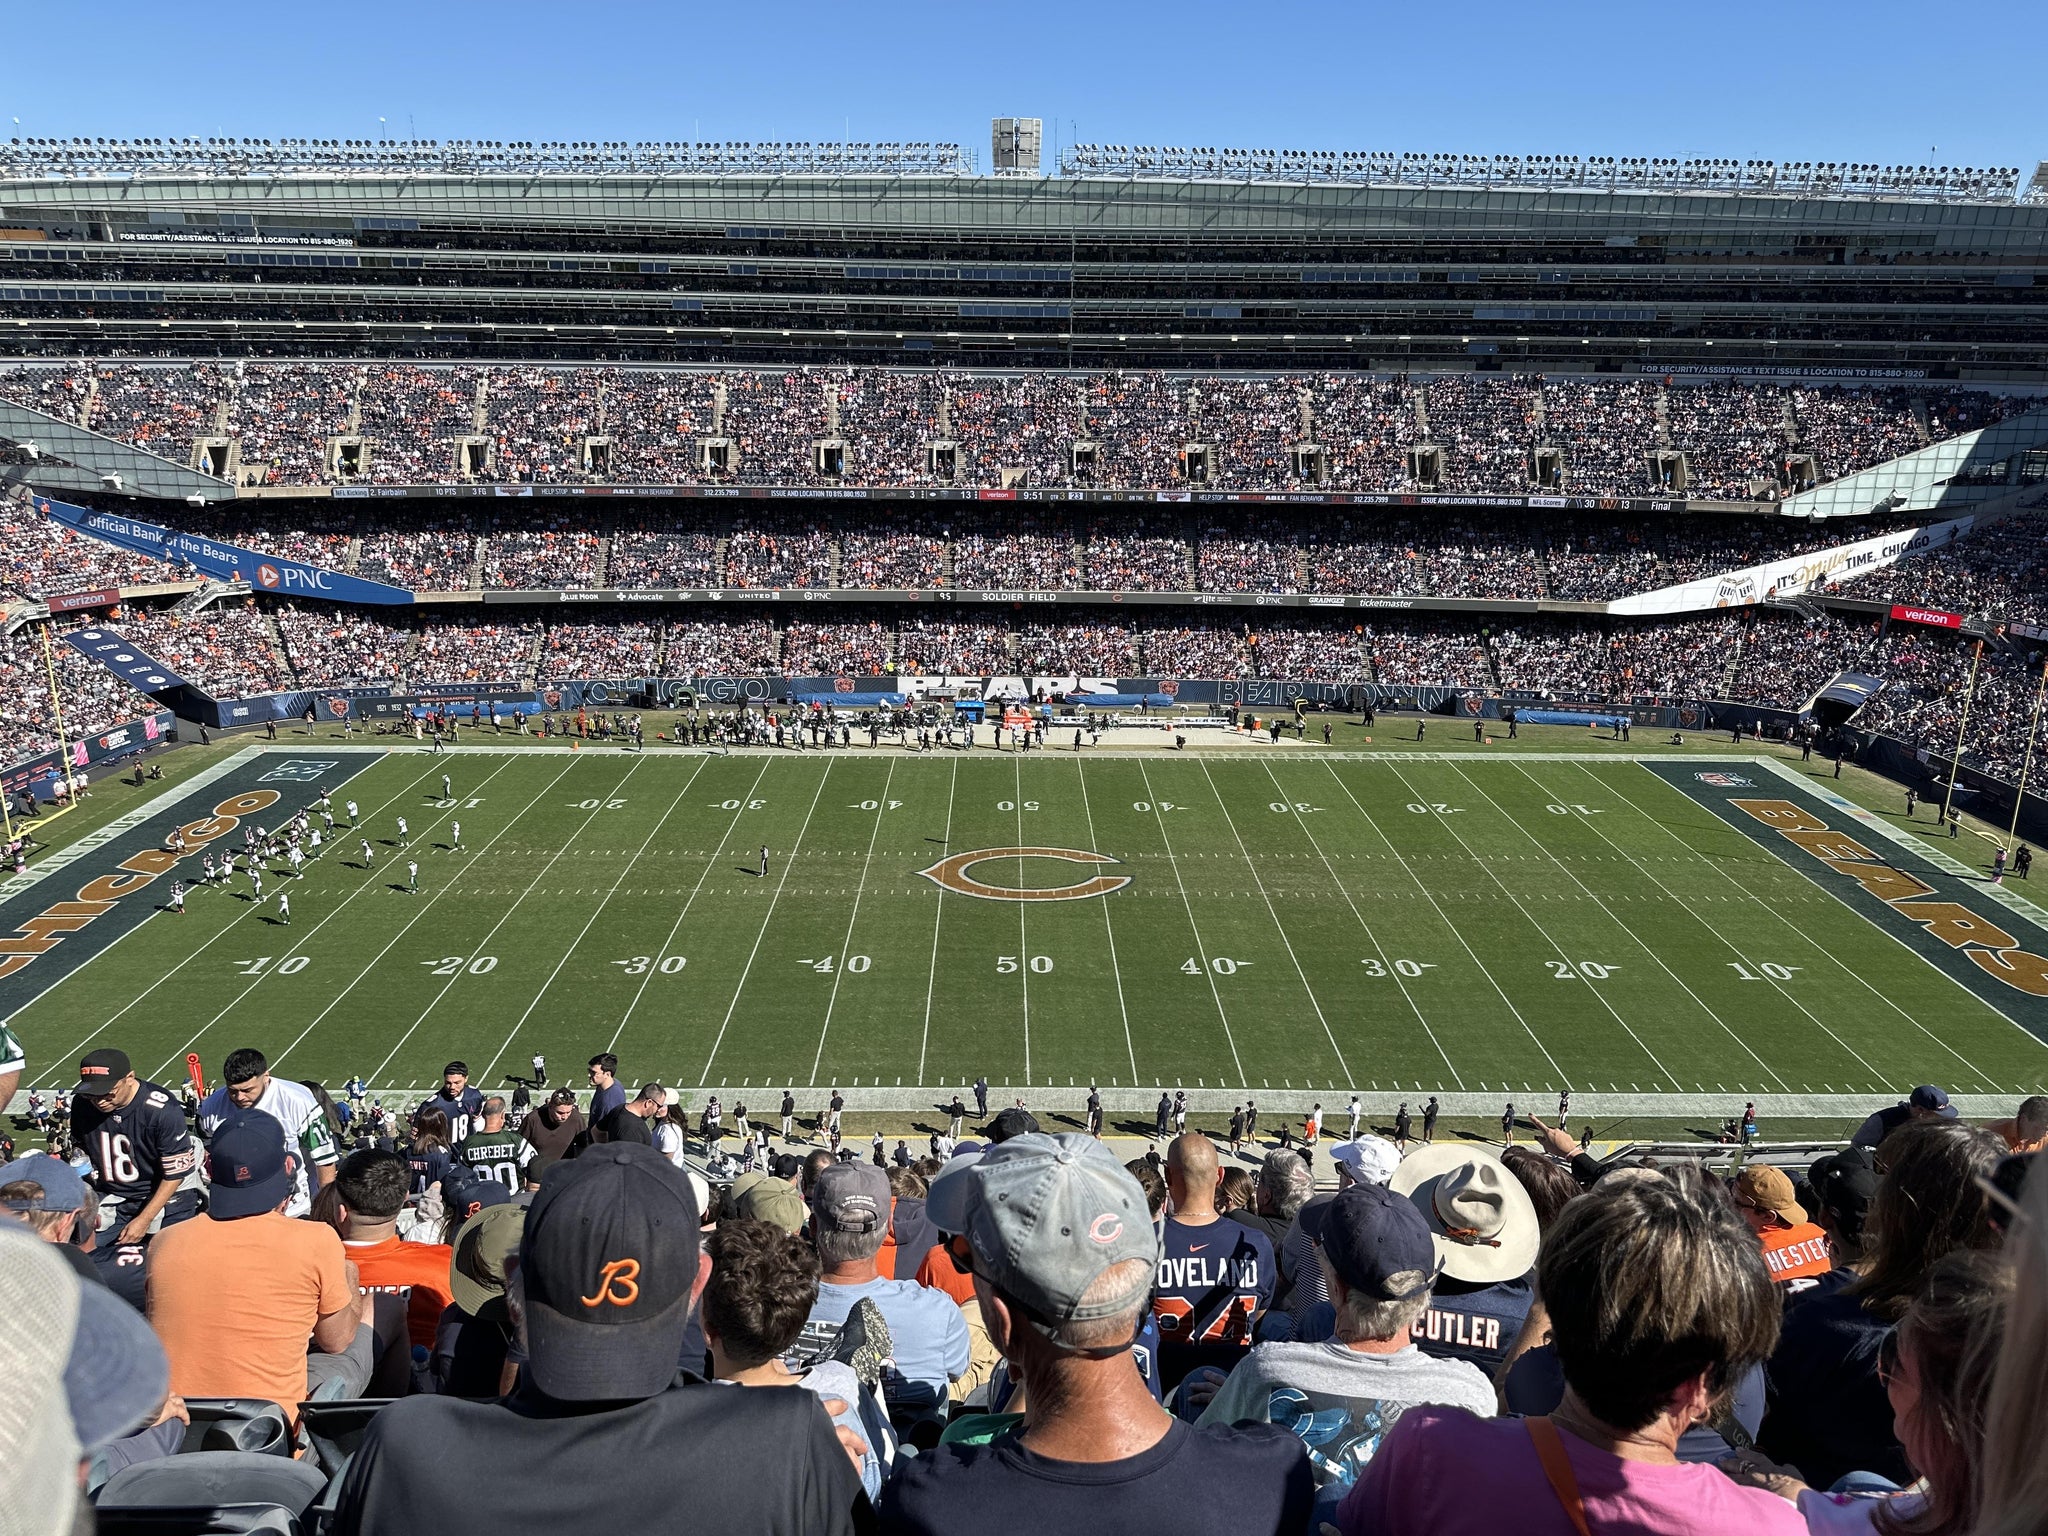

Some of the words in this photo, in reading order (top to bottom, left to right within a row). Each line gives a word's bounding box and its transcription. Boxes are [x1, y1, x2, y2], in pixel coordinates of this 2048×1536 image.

[120, 233, 135, 241] FOR
[137, 233, 217, 242] SECURITY/ASSISTANCE
[219, 235, 236, 243] TEXT
[1659, 365, 1752, 375] SECURITY/ASSISTANCE
[1755, 367, 1775, 375] TEXT
[1810, 368, 1853, 376] LOCATION
[347, 489, 368, 498] Kicking
[378, 488, 407, 496] Fairbairn
[436, 488, 443, 496] 10
[444, 488, 457, 496] PTS
[541, 488, 554, 496] HELP
[555, 488, 568, 496] STOP
[771, 489, 786, 497] ISSUE
[787, 489, 799, 497] AND
[799, 489, 825, 497] LOCATION
[825, 489, 832, 497] TO
[910, 491, 915, 499] 3
[960, 491, 971, 499] 13
[1023, 491, 1043, 500] 9:51
[1060, 492, 1066, 500] 3
[1071, 492, 1081, 500] 23
[1113, 492, 1124, 500] 10
[1147, 492, 1154, 501] 4
[1199, 494, 1211, 502] HELP
[1211, 494, 1224, 502] STOP
[1421, 497, 1437, 505] ISSUE
[1438, 497, 1450, 505] AND
[1450, 497, 1477, 506] LOCATION
[1478, 498, 1486, 506] TO
[1584, 499, 1595, 508] 30
[1620, 500, 1630, 509] 13
[1651, 501, 1671, 511] Final
[88, 515, 130, 535] Official
[133, 525, 163, 544] Bank
[166, 536, 178, 546] of
[180, 540, 200, 553] the
[203, 544, 239, 565] Bears
[1846, 552, 1876, 570] TIME,
[1882, 536, 1931, 560] CHICAGO
[281, 568, 333, 591] PNC
[60, 594, 106, 608] verizon
[560, 593, 579, 601] BLUE
[579, 593, 599, 601] MOON
[982, 593, 1024, 602] SOLDIER
[1029, 593, 1057, 602] FIELD
[1265, 597, 1283, 605] PNC
[1359, 599, 1413, 608] ticketmaster
[1905, 610, 1948, 625] verizon
[32, 851, 85, 874] ALL
[78, 833, 113, 847] OF
[108, 815, 146, 829] US
[1726, 798, 2048, 998] BEARS
[239, 956, 311, 976] 10
[431, 956, 498, 976] 20
[623, 956, 687, 975] 30
[812, 955, 872, 974] 40
[996, 955, 1054, 974] 50
[1180, 956, 1237, 975] 40
[1361, 958, 1423, 978] 30
[1544, 960, 1610, 980] 20
[1726, 961, 1794, 981] 10
[145, 1090, 170, 1109] 18
[452, 1113, 469, 1144] 18
[100, 1131, 140, 1183] 18
[467, 1143, 515, 1162] CHREBET
[409, 1160, 429, 1171] SWIFT
[1149, 1257, 1258, 1290] OVELAND
[581, 1257, 641, 1308] B
[1410, 1309, 1501, 1351] CUTLER
